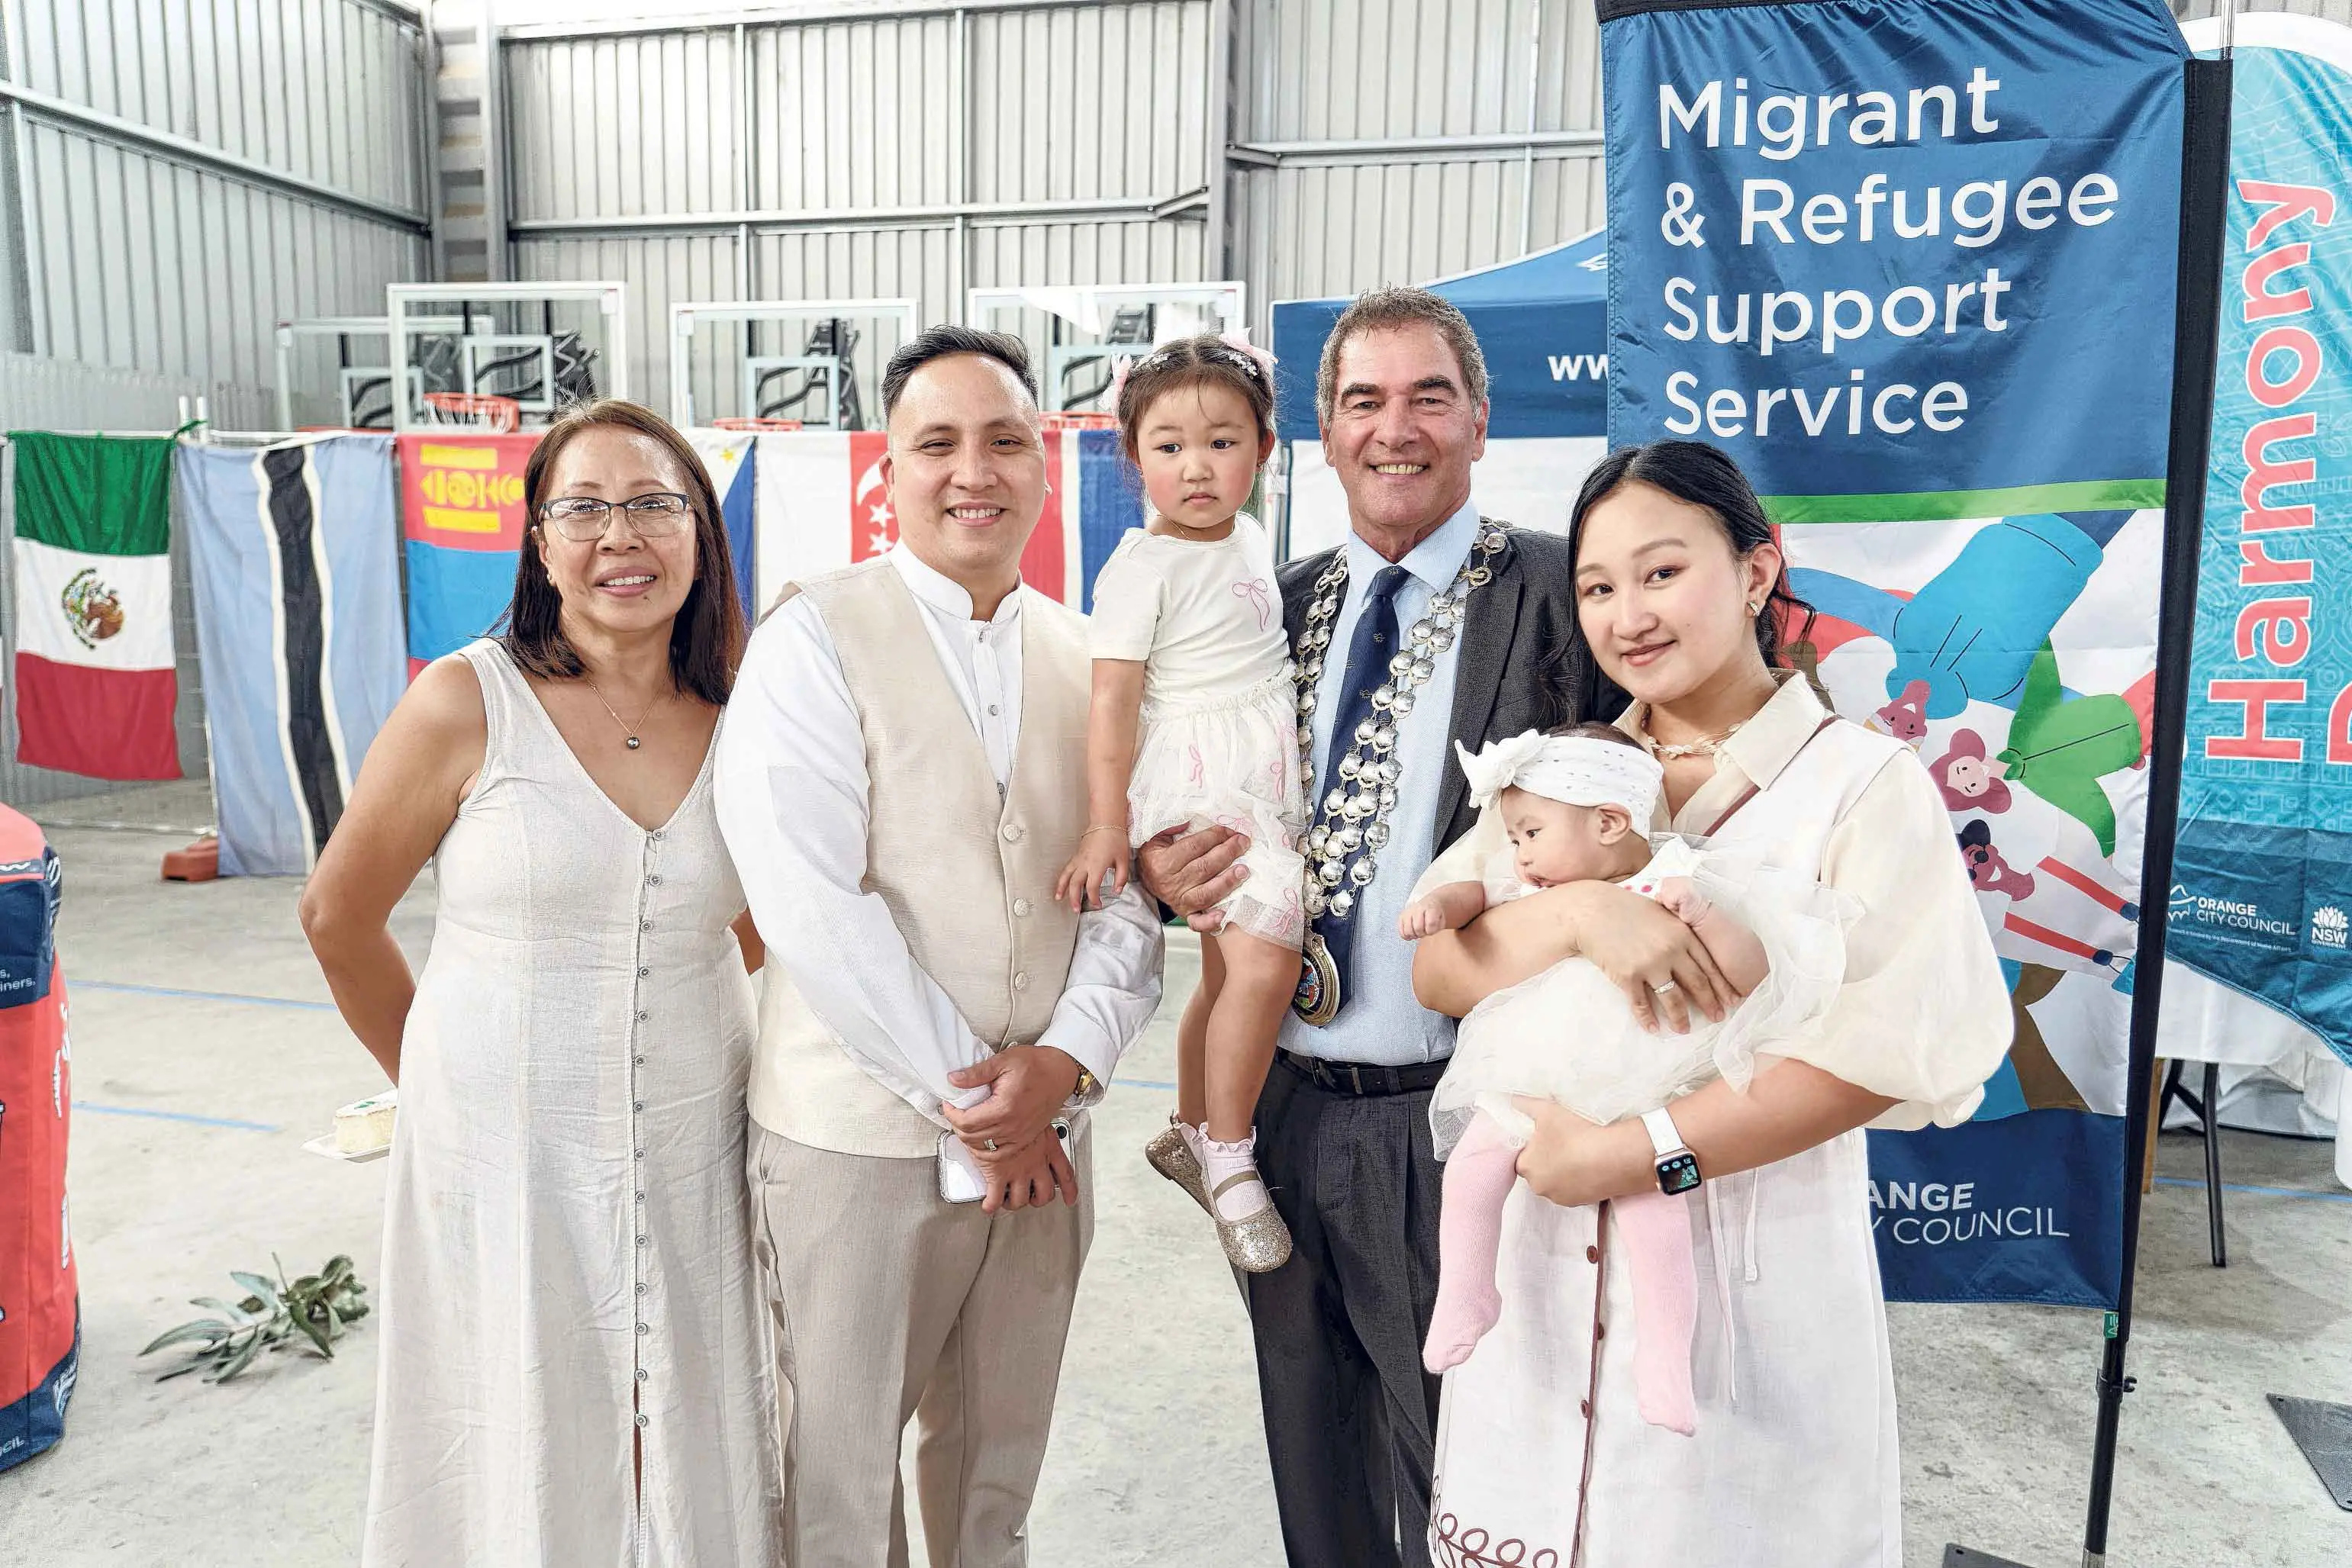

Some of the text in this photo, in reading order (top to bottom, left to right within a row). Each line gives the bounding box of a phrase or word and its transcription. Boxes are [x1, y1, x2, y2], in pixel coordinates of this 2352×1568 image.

[1658, 66, 2000, 161] Migrant
[1661, 172, 2118, 249] & Refugee
[1662, 268, 2012, 356] Support
[1663, 369, 1969, 438] Service
[2204, 179, 2336, 762] Harmony
[2196, 909, 2296, 935] CITY COUNCIL
[2197, 897, 2257, 916] ORANGE
[2311, 926, 2347, 944] NSW
[1893, 1206, 2070, 1245] COUNCIL
